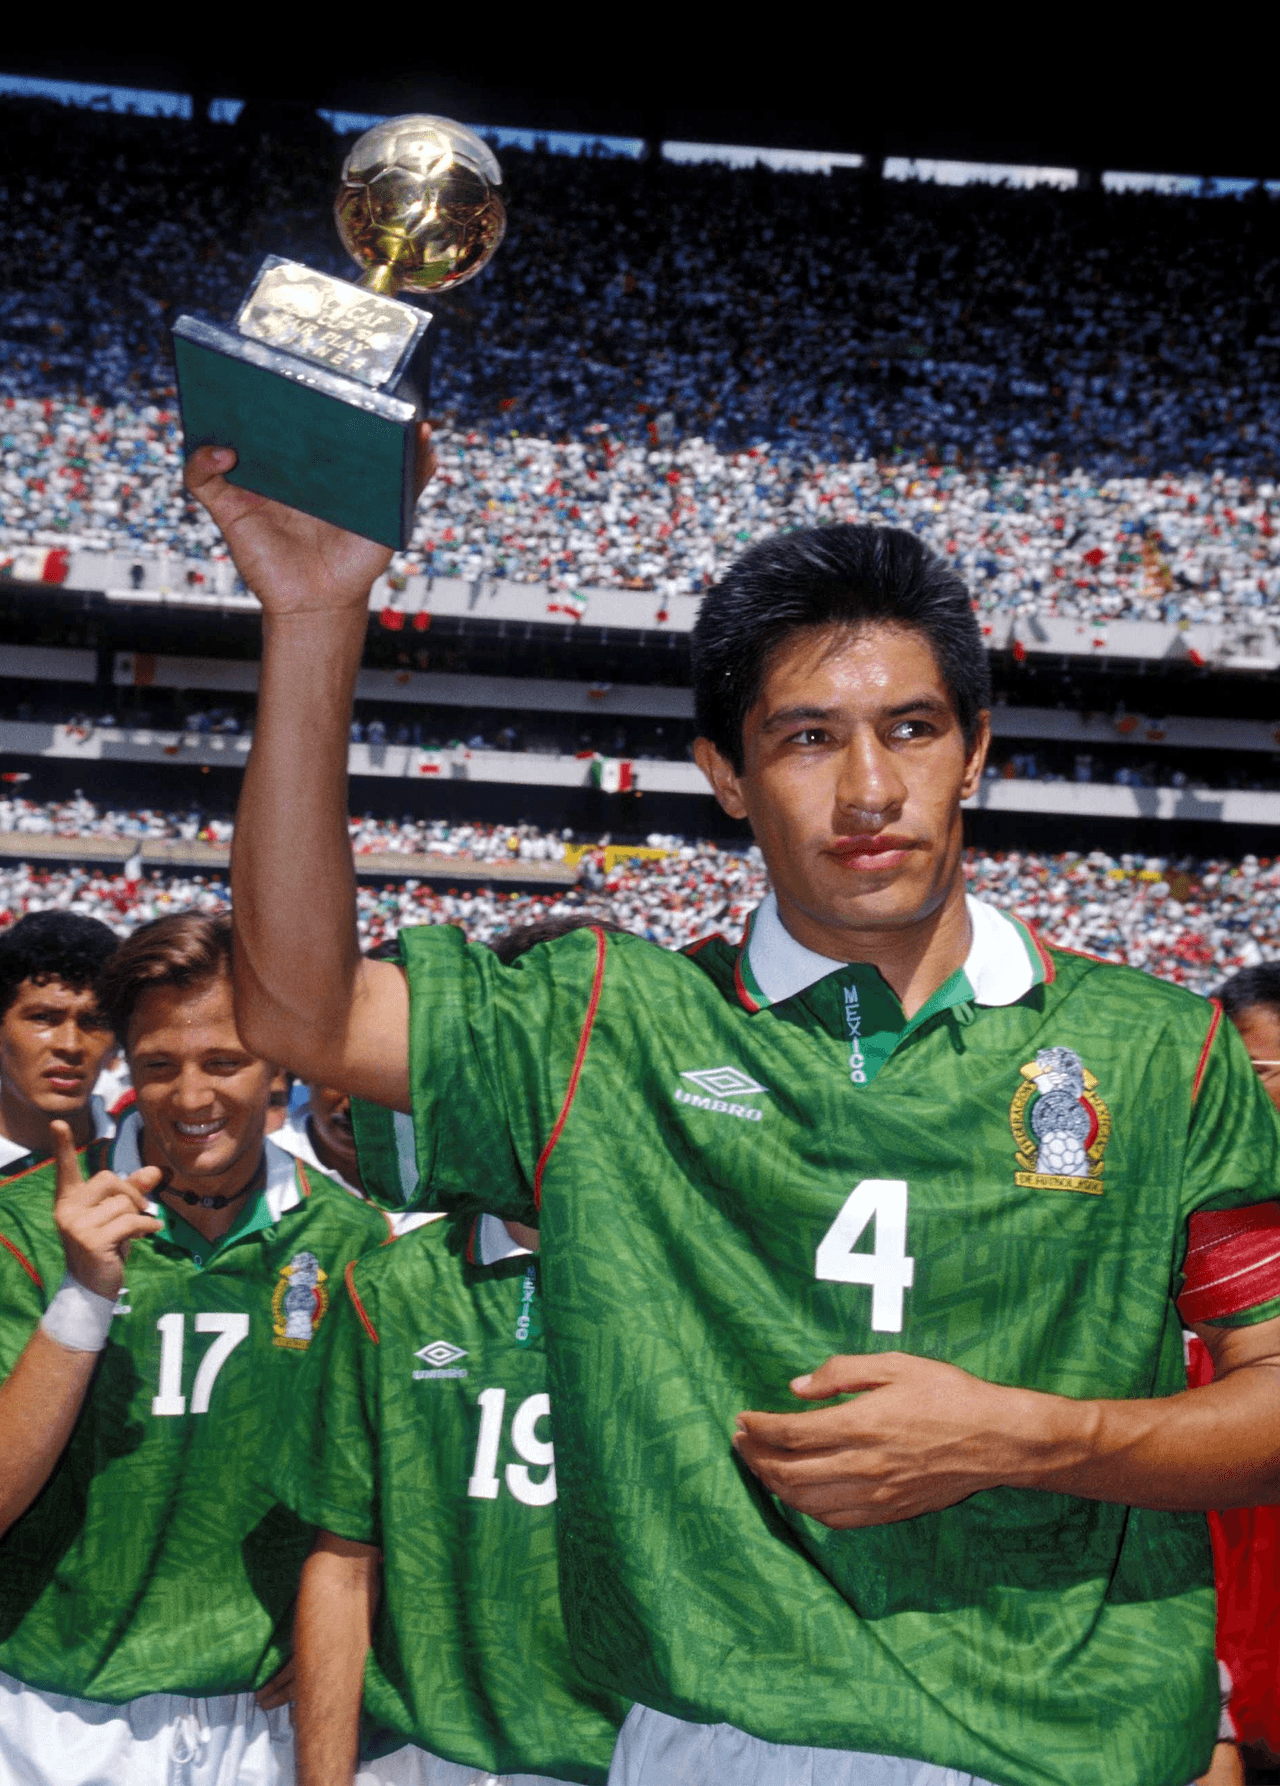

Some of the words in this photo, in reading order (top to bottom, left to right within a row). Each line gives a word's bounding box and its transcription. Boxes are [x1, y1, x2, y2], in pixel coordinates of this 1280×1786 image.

[319, 330, 372, 356] PLAY
[843, 985, 867, 1083] MEXICO
[674, 1088, 763, 1121] UMBRO
[815, 1179, 915, 1333] 4
[152, 1313, 250, 1416] 17
[467, 1387, 558, 1507] 19
